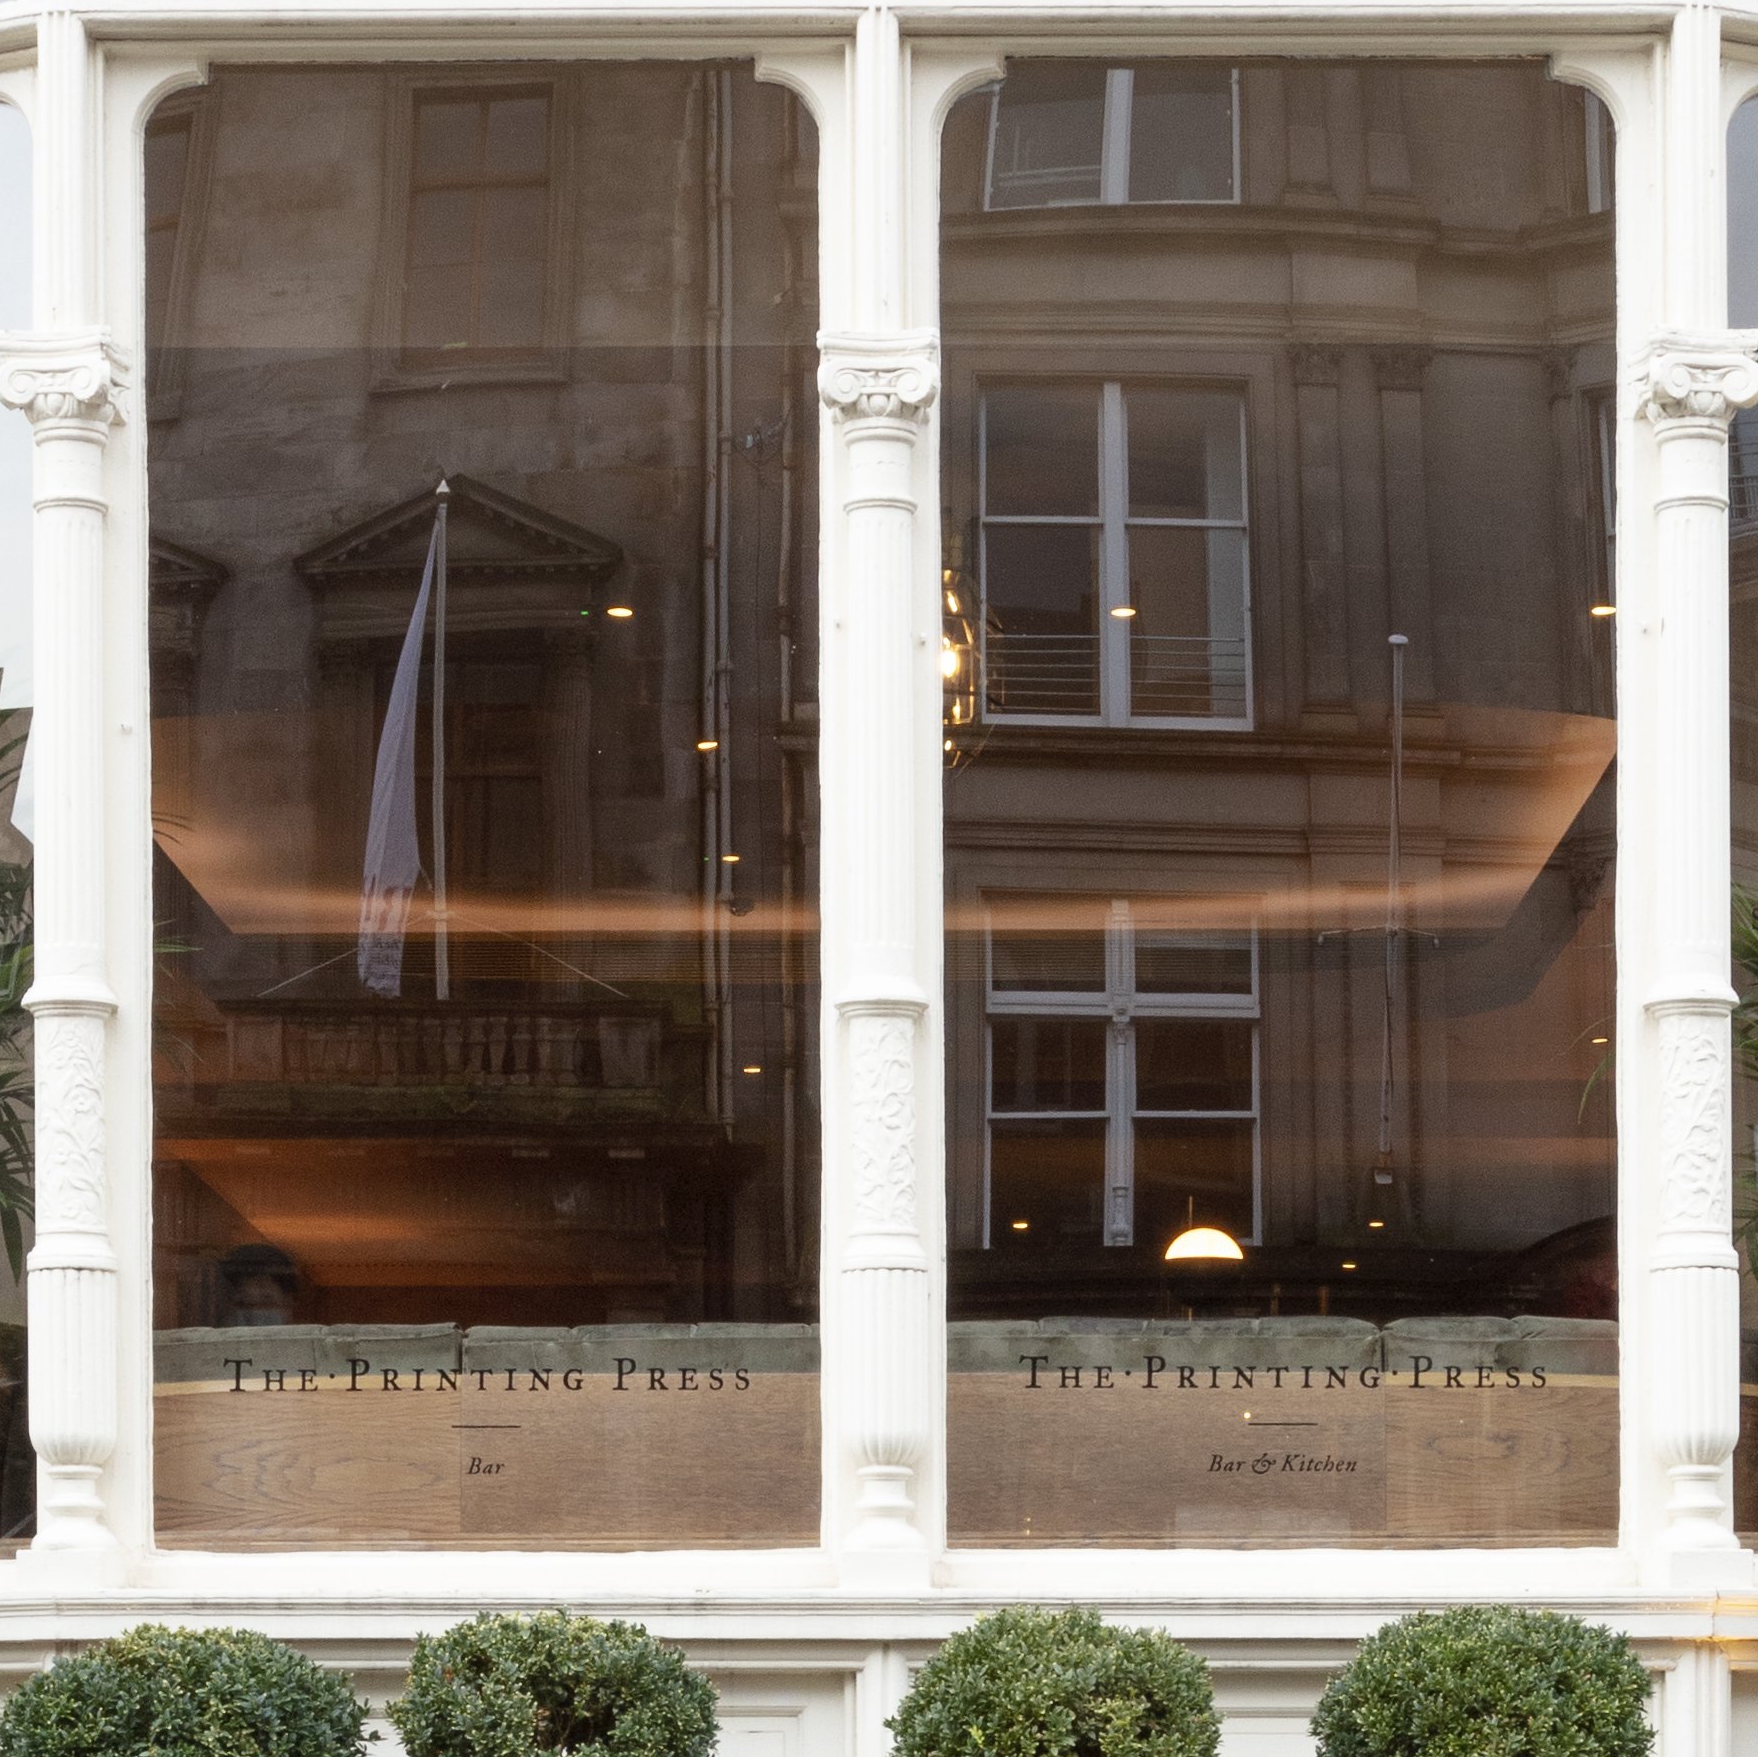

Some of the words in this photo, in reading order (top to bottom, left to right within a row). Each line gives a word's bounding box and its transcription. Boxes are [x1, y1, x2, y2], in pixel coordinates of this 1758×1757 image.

[468, 1456, 505, 1476] Bar
[1208, 1454, 1246, 1474] Bar
[1251, 1453, 1275, 1475] &
[1281, 1454, 1357, 1475] Kitchen
